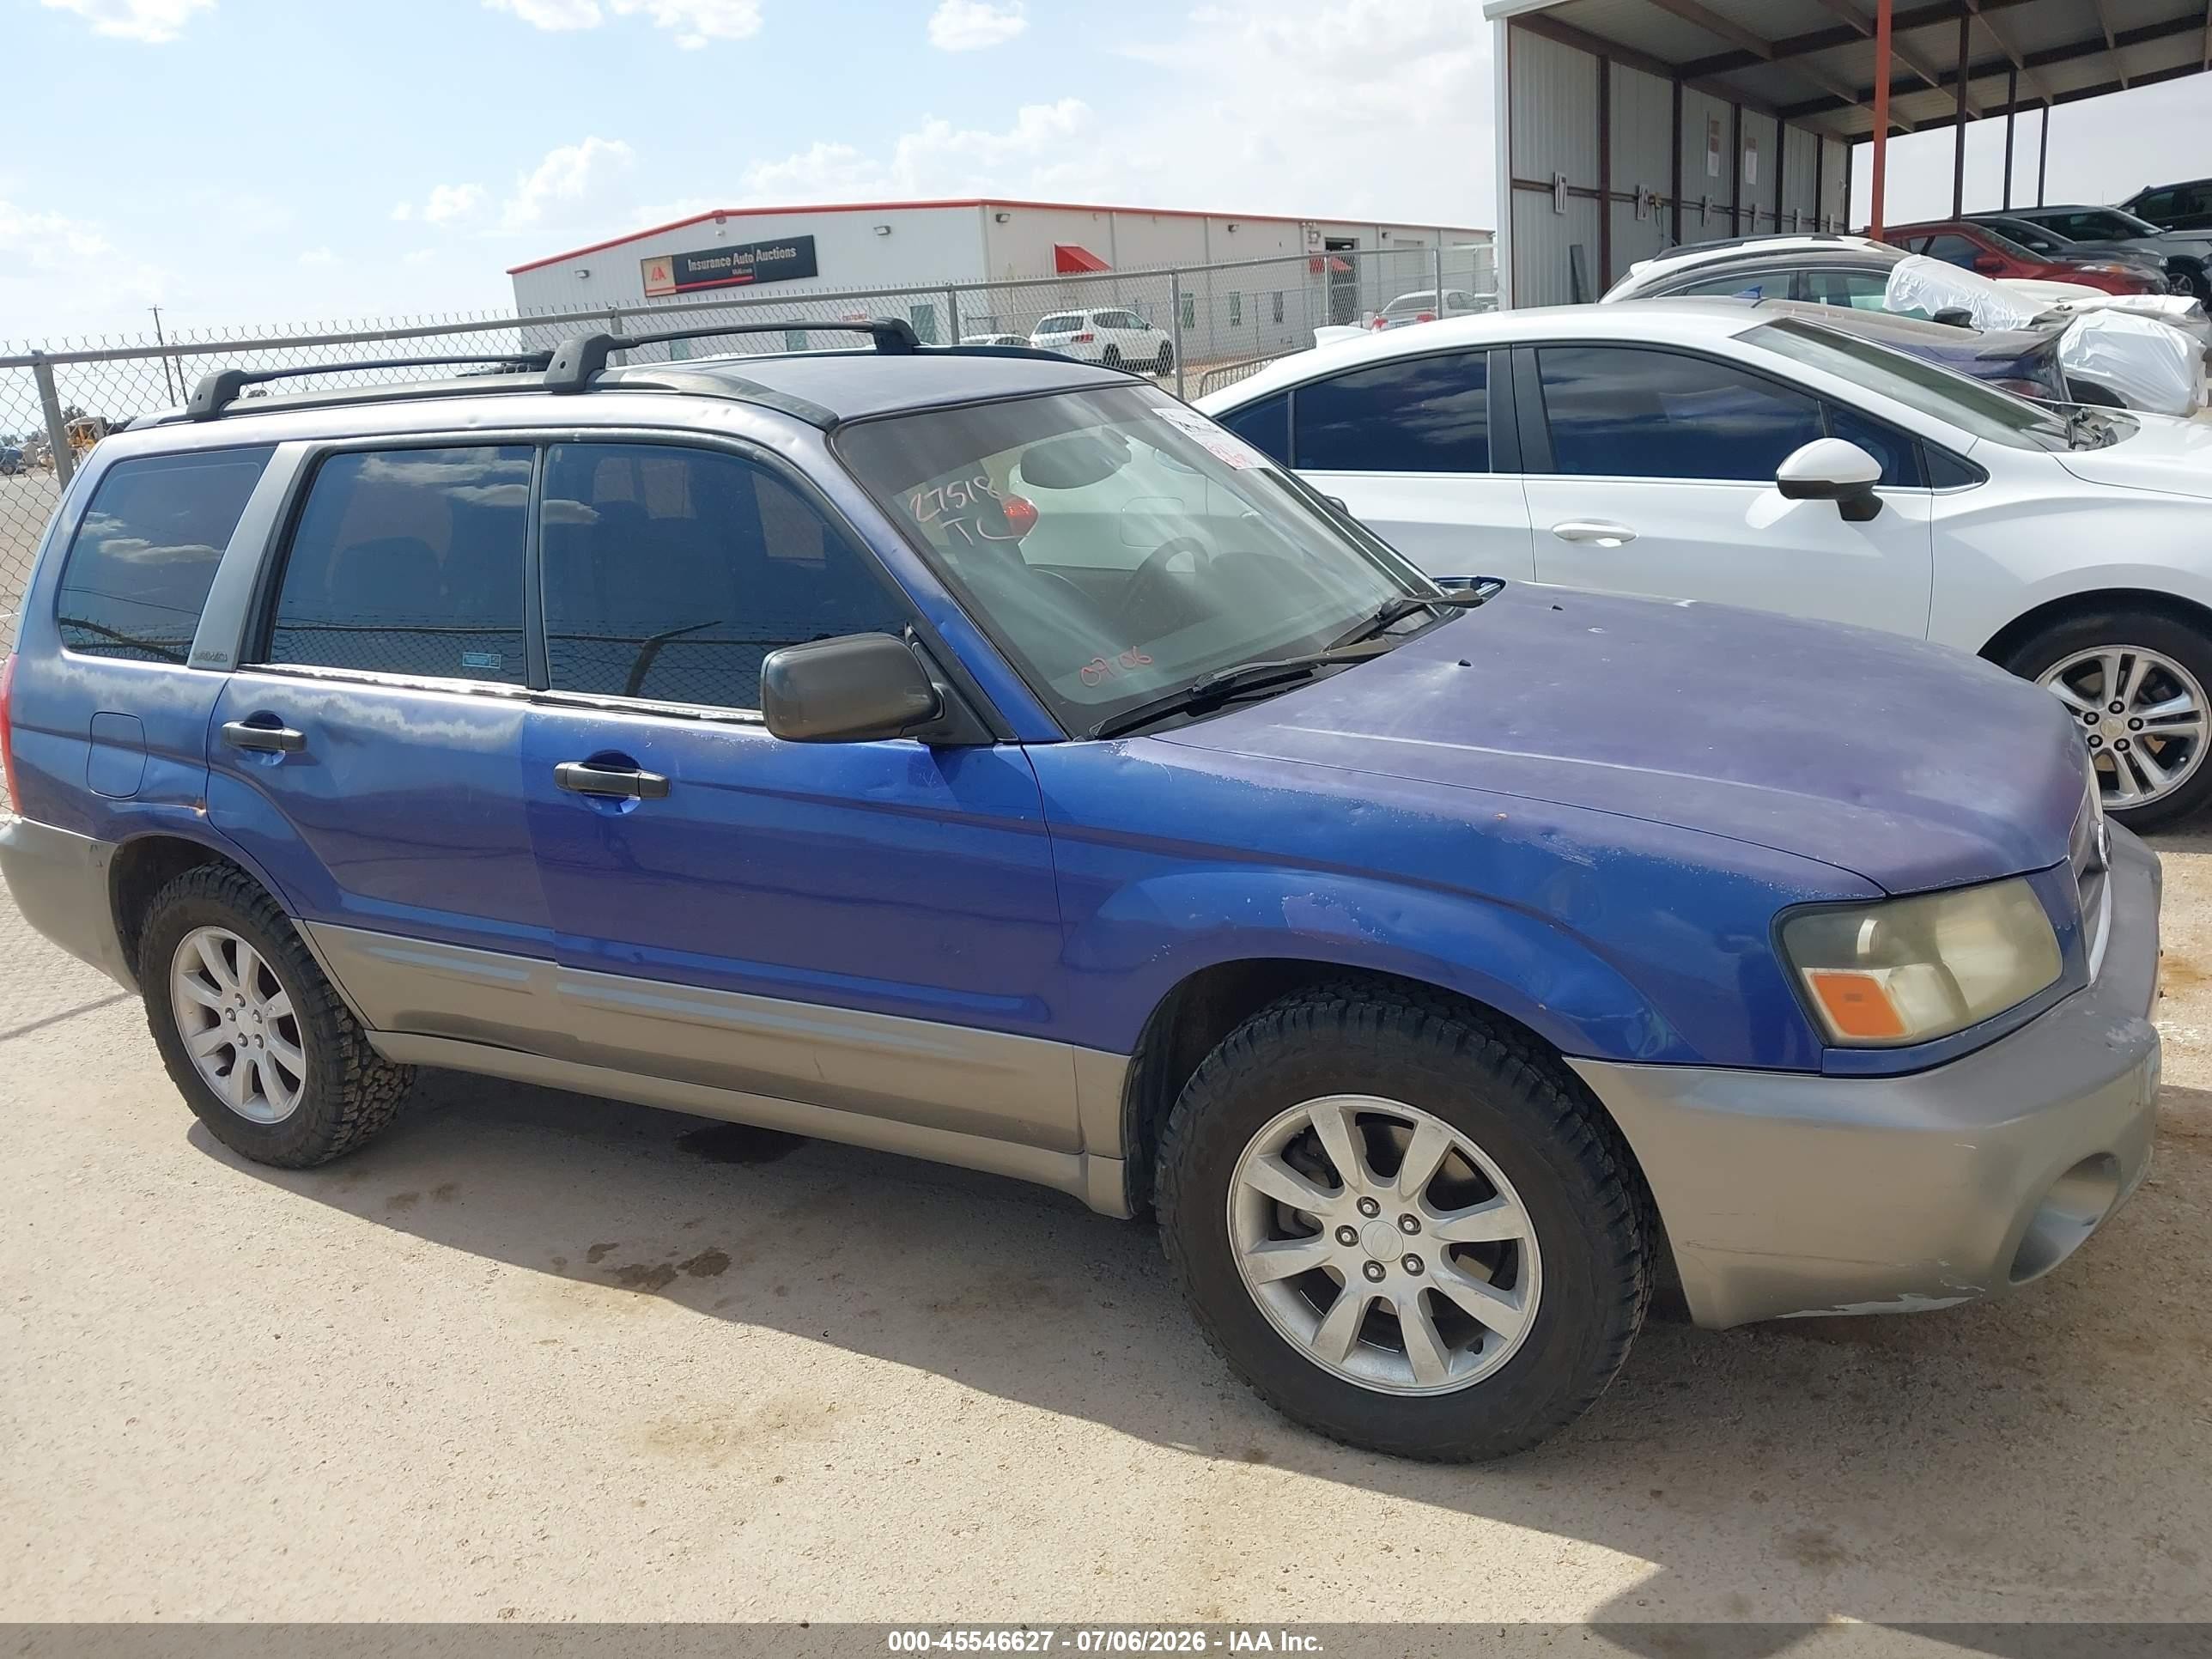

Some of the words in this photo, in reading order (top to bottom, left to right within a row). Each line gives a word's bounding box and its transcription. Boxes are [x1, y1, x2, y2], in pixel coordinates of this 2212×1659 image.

[688, 256, 731, 272] Insurance
[732, 252, 754, 266] Auto
[757, 246, 797, 263] Auctions
